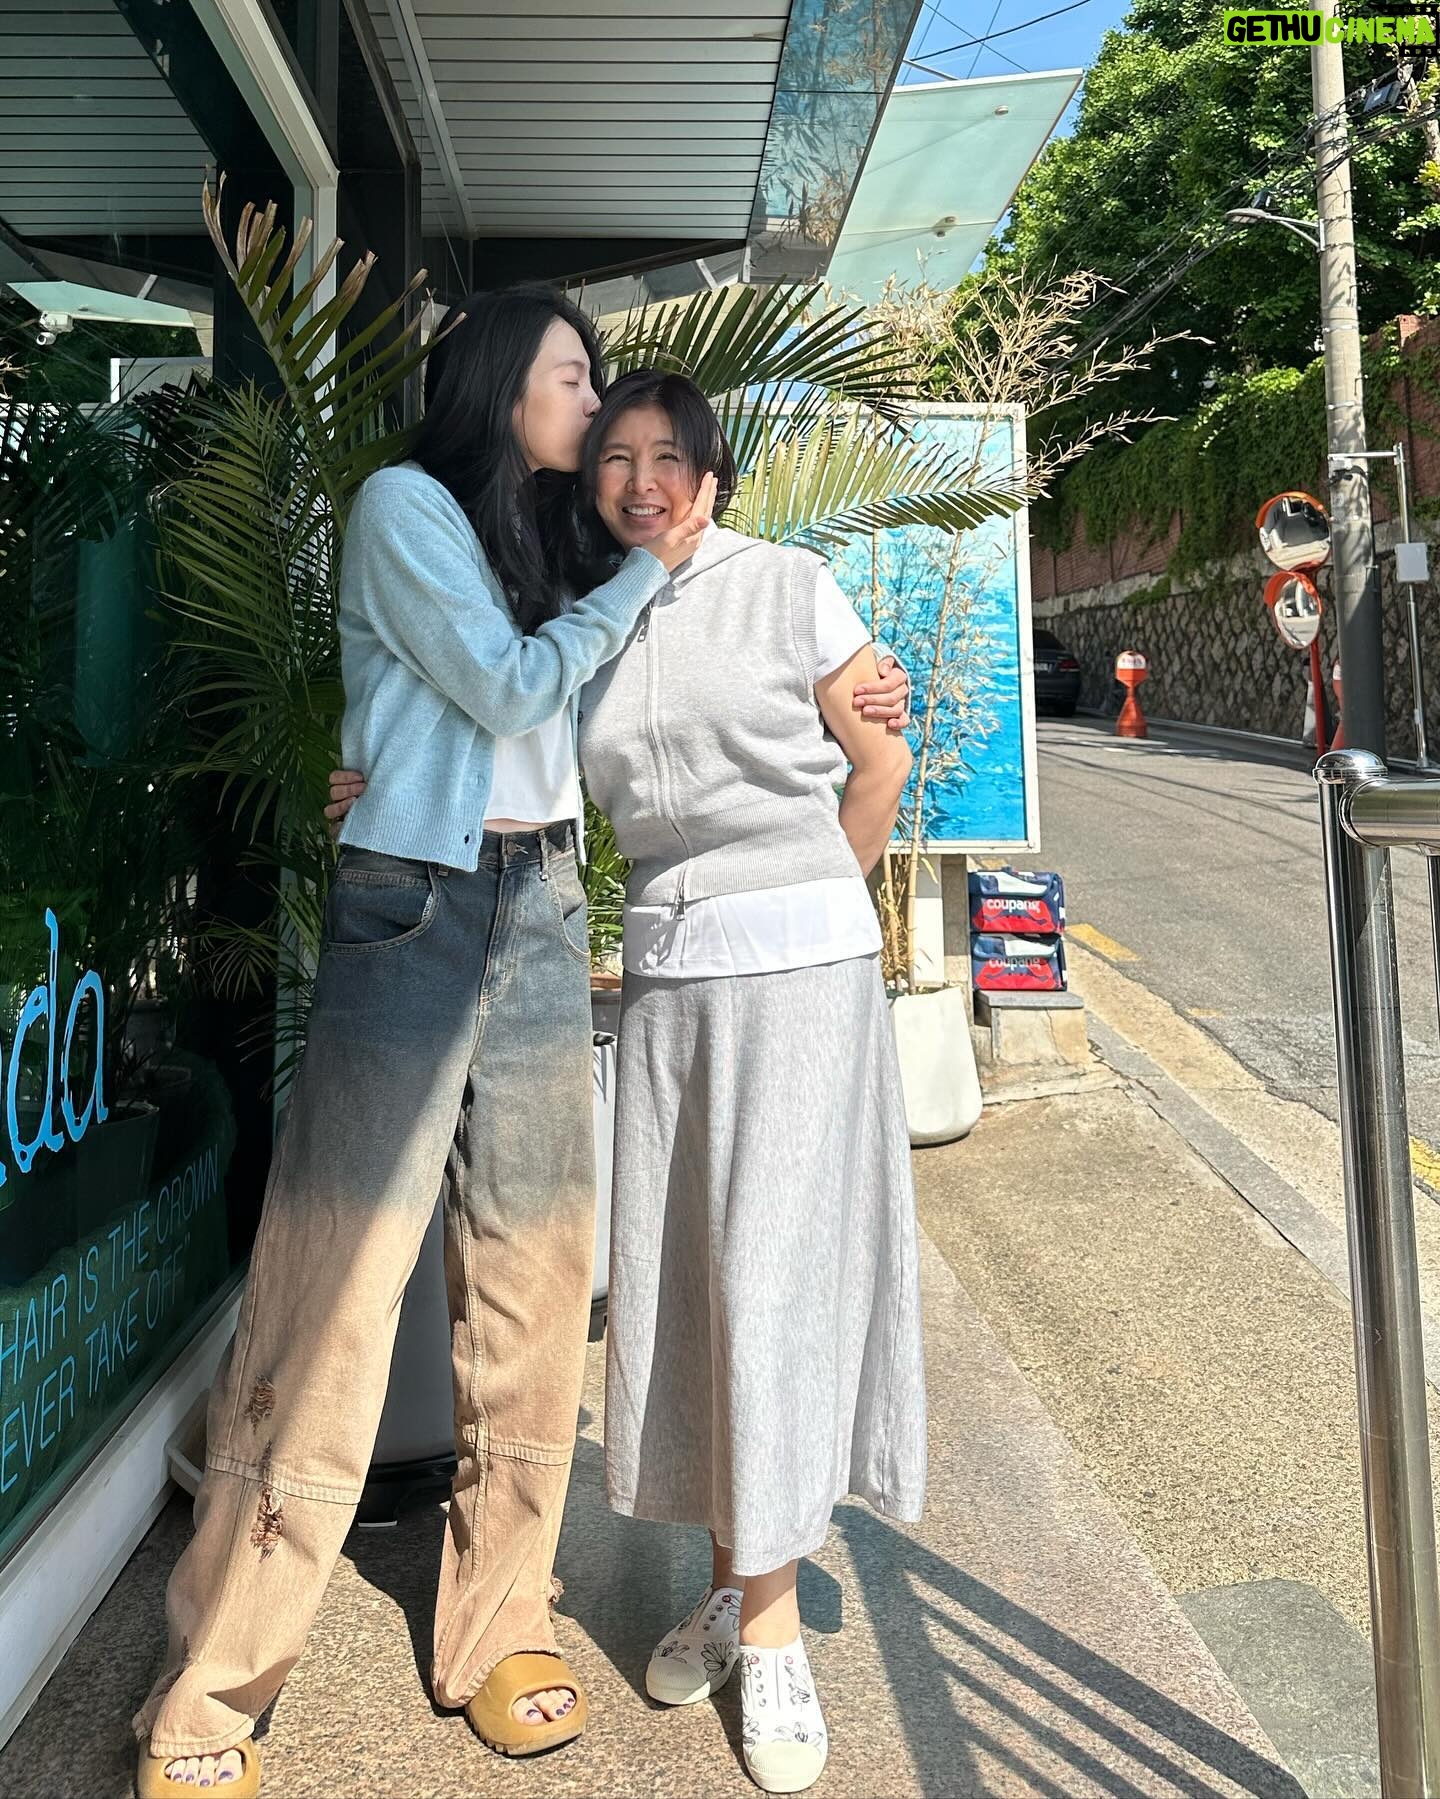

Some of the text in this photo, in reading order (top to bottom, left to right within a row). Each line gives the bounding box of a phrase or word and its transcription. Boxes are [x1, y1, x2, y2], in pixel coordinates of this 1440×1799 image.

[987, 898, 1041, 913] coupang
[0, 907, 108, 1187] da
[0, 1143, 218, 1385] HAIR IS THE CROWN
[85, 1287, 139, 1399] TAKE
